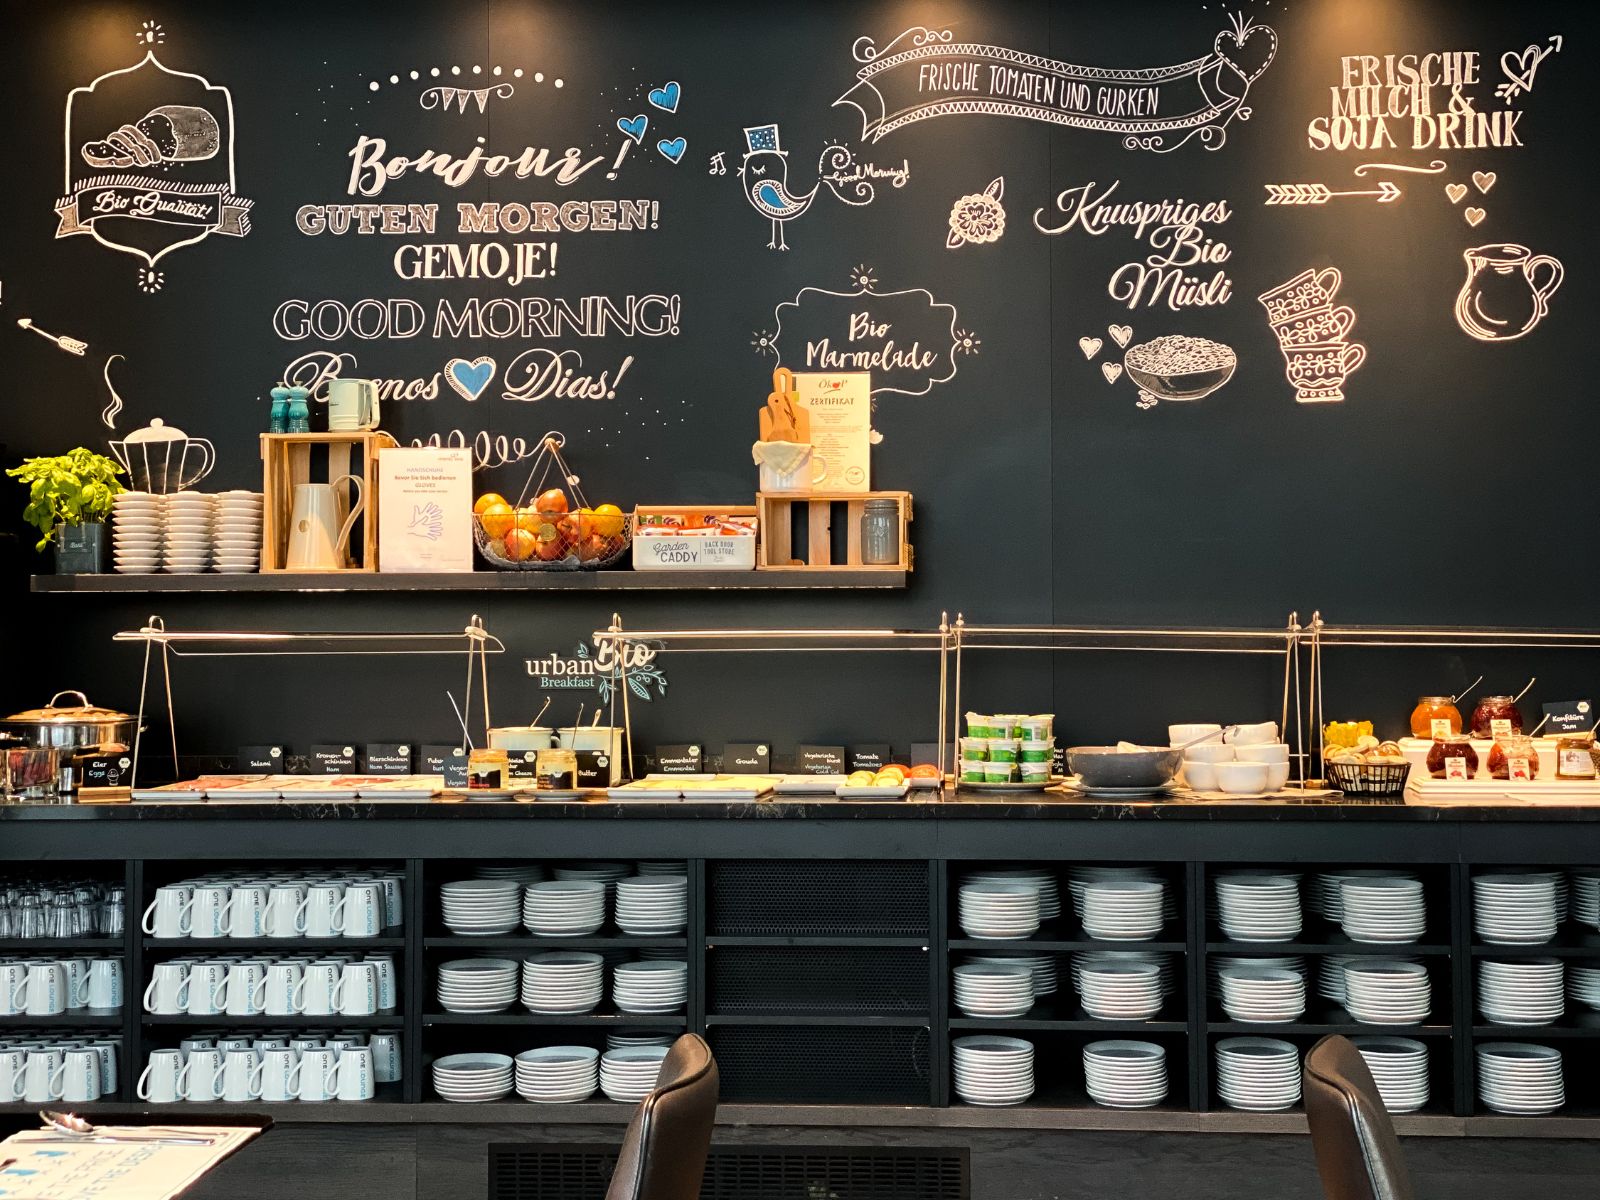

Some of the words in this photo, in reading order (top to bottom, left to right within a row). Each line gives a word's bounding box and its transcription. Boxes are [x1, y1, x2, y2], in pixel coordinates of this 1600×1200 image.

[1341, 51, 1480, 90] FRISCHE
[989, 65, 1055, 104] TOMATEN
[1060, 80, 1091, 112] UND
[1097, 86, 1159, 116] GURKEN
[1330, 84, 1431, 119] MILCH
[1448, 83, 1476, 116] &
[1308, 114, 1398, 151] SOJA
[1411, 110, 1525, 149] DRINK
[93, 190, 130, 213] Bio
[131, 191, 214, 221] Qualität!
[295, 204, 439, 236] GUTEN
[458, 199, 660, 234] MORGEN!
[1033, 179, 1233, 240] Knuspriges
[393, 241, 559, 287] GEMOJE!
[1147, 224, 1232, 268] Bio
[1108, 262, 1233, 312] Müsli
[272, 299, 426, 341] GOOD
[432, 293, 681, 339] MORNING!
[848, 312, 893, 342] Bio
[805, 338, 938, 371] Marmelade
[283, 351, 442, 402] Benos
[501, 347, 636, 401] Dias!
[810, 397, 854, 406] ZERTIFIKAT
[653, 541, 690, 556] Garden
[661, 551, 698, 563] CADDY
[525, 653, 595, 676] urban
[540, 676, 595, 688] Breakfast
[1552, 713, 1585, 723] Konfitüre
